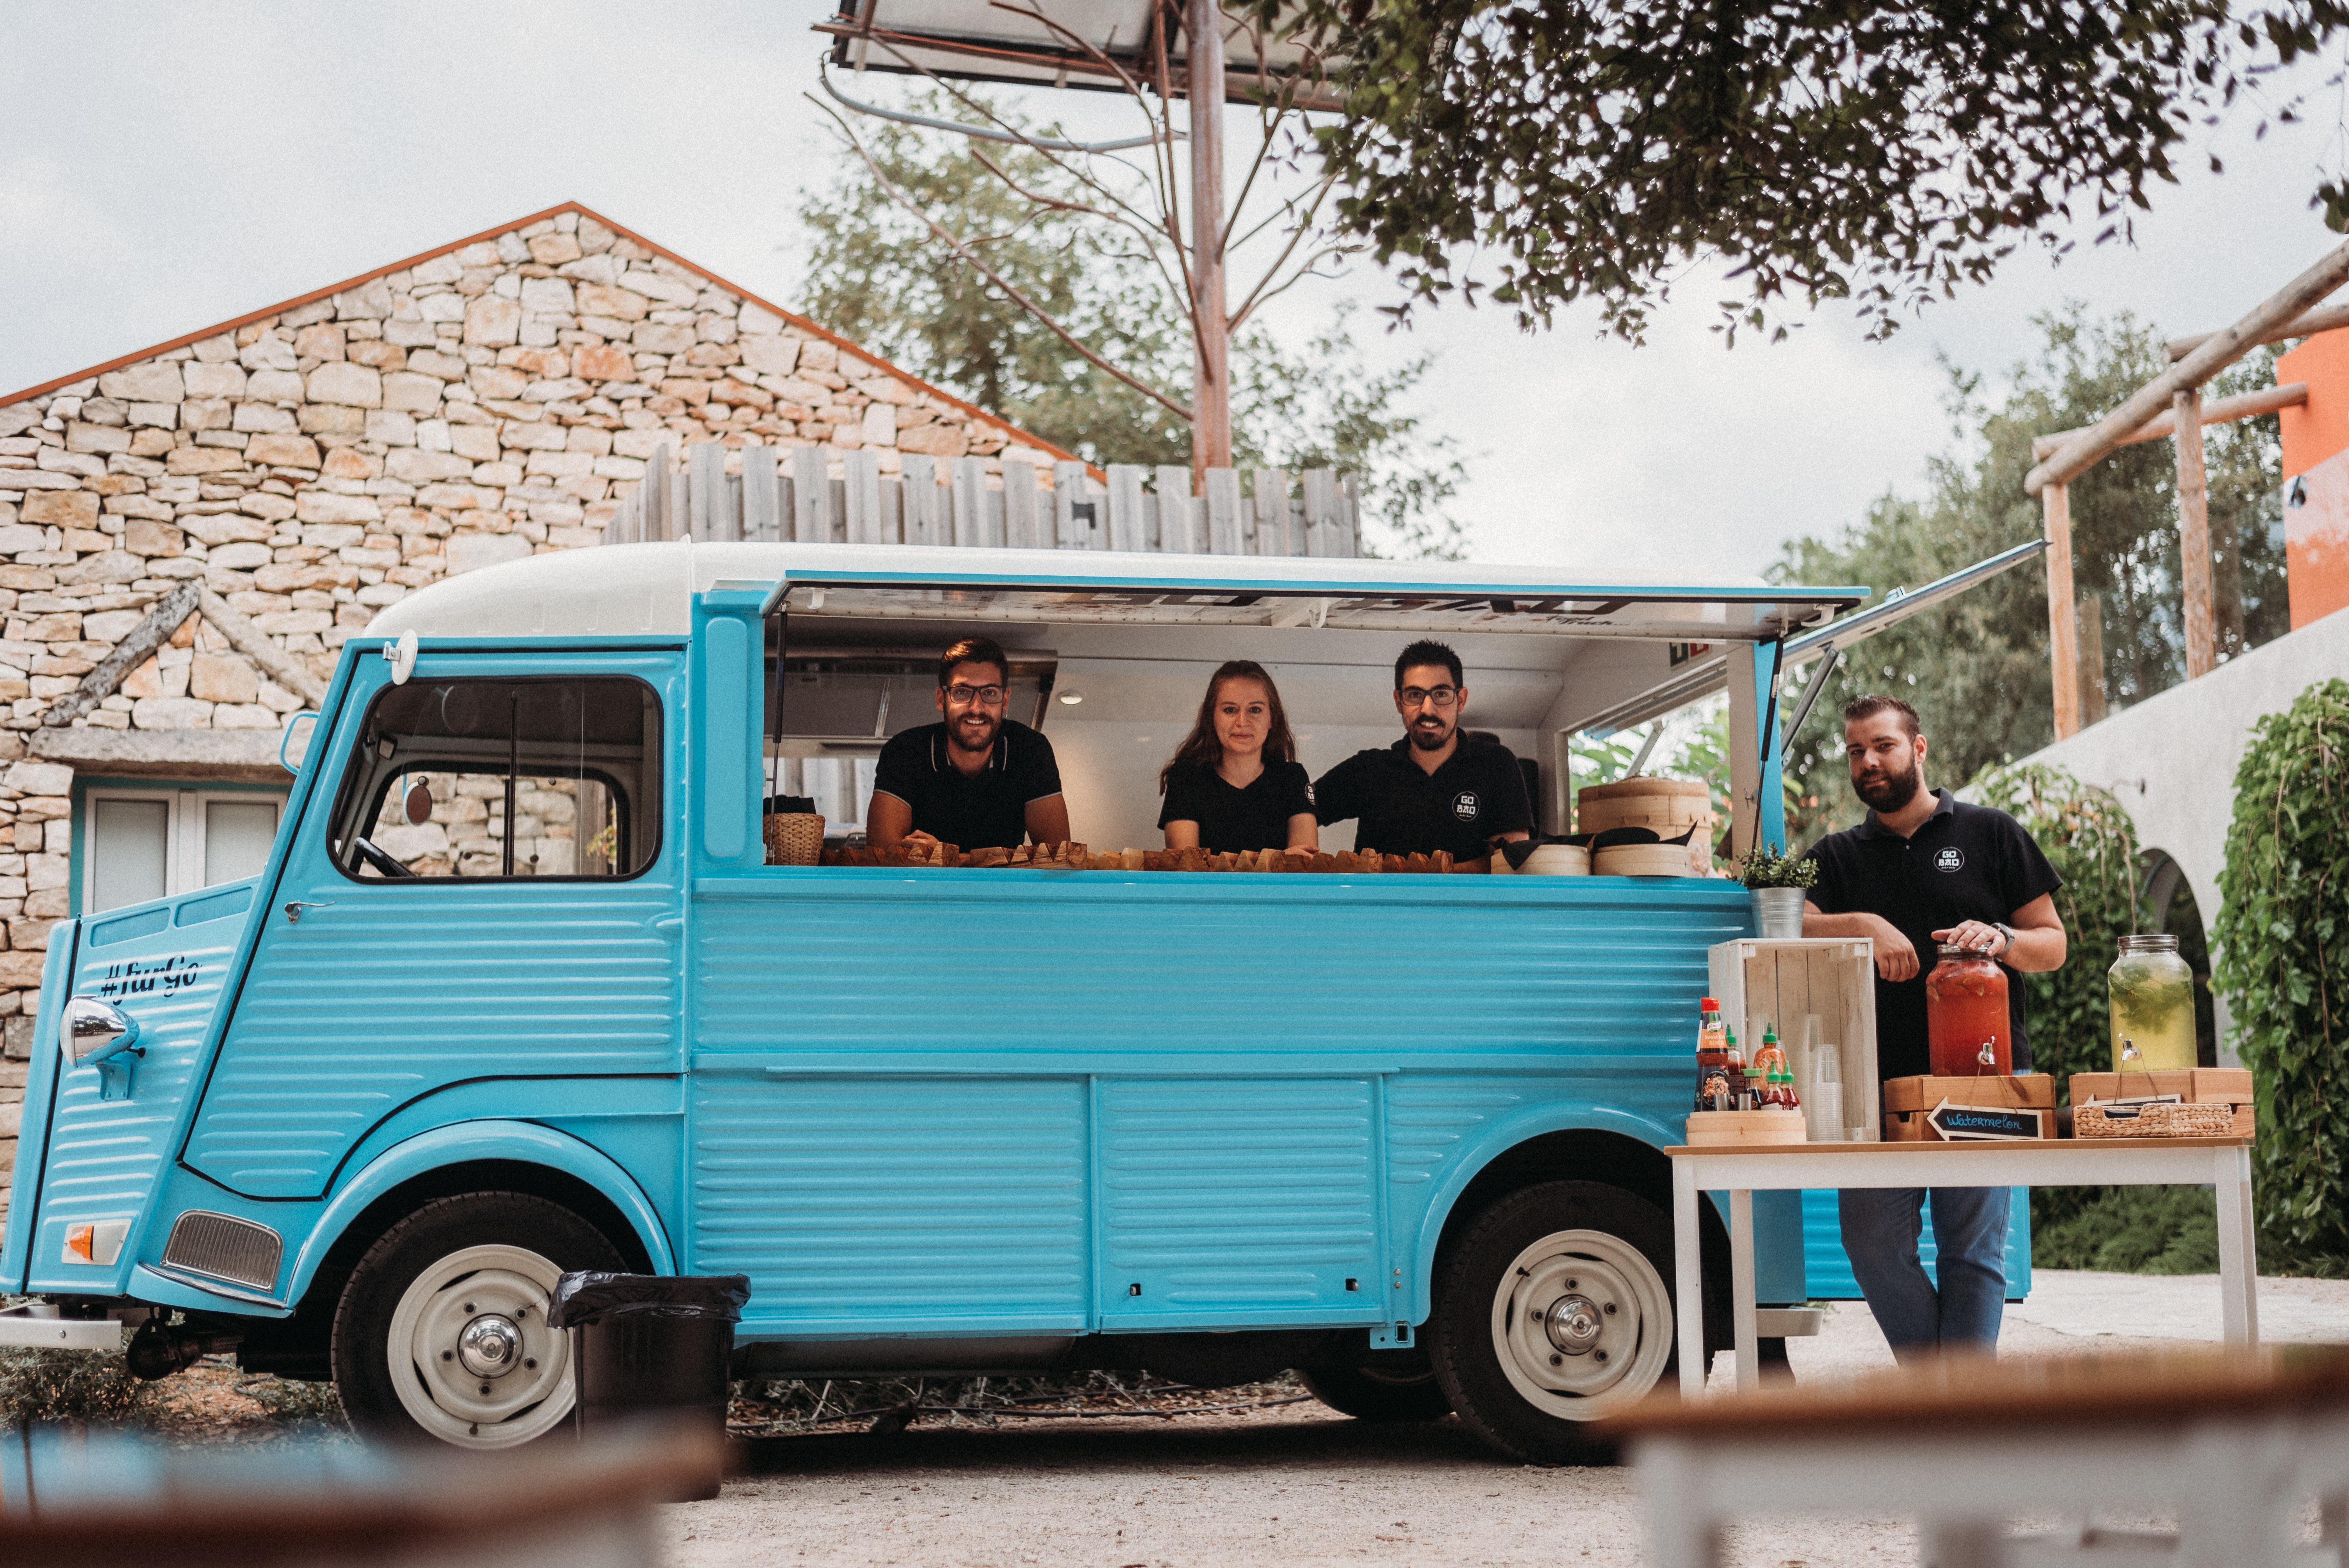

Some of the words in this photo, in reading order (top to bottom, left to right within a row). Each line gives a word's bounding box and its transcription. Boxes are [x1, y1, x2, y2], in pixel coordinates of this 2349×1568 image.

[1461, 796, 1474, 804] GO
[1457, 804, 1476, 814] BAO
[1947, 1113, 2022, 1130] Watermelon
